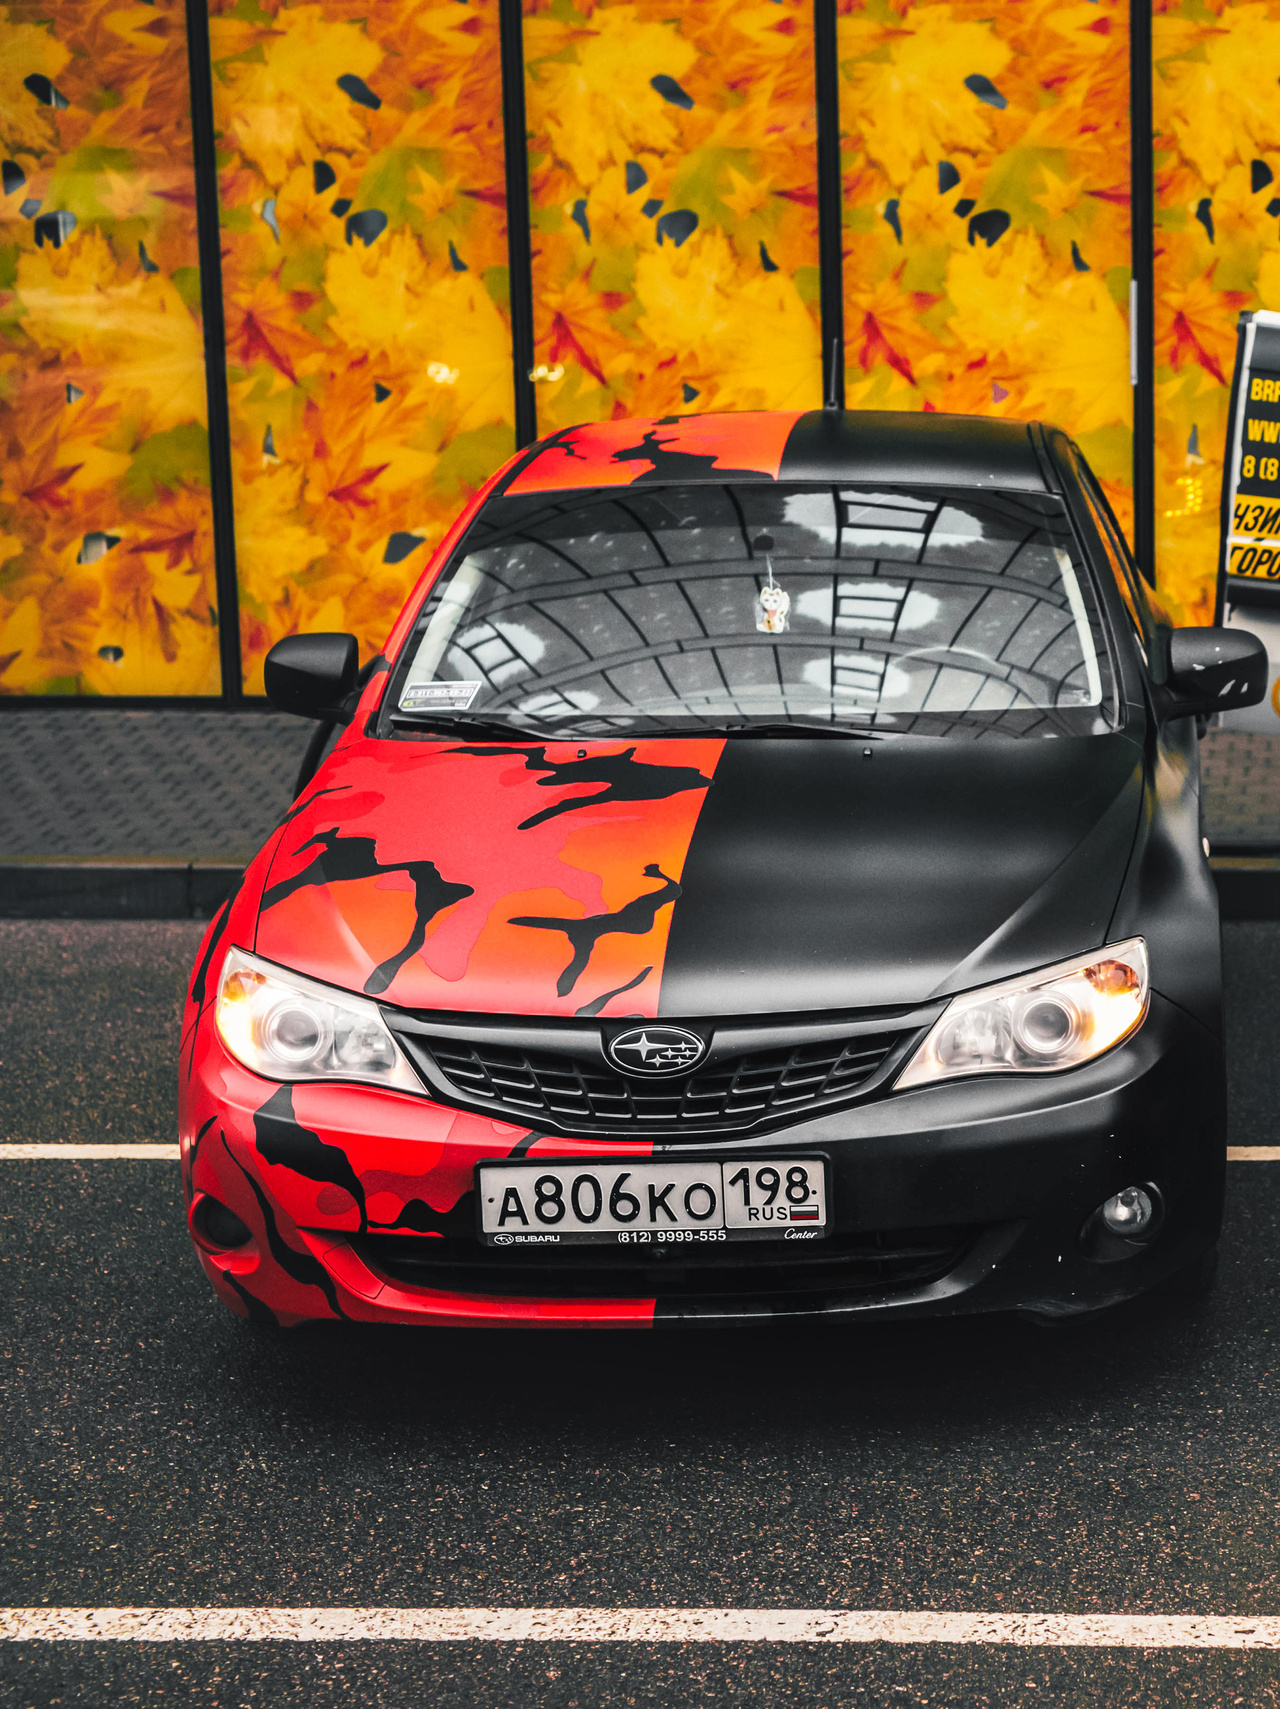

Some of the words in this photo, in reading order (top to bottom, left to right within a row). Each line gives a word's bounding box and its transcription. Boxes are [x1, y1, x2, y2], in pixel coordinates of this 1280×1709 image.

[1242, 455, 1256, 478] 8
[728, 1166, 810, 1206] 198
[748, 1206, 788, 1221] RUS
[515, 1234, 561, 1243] SUBARU
[617, 1231, 652, 1244] (812)
[657, 1230, 727, 1243] 9999-555
[784, 1228, 818, 1240] Center
